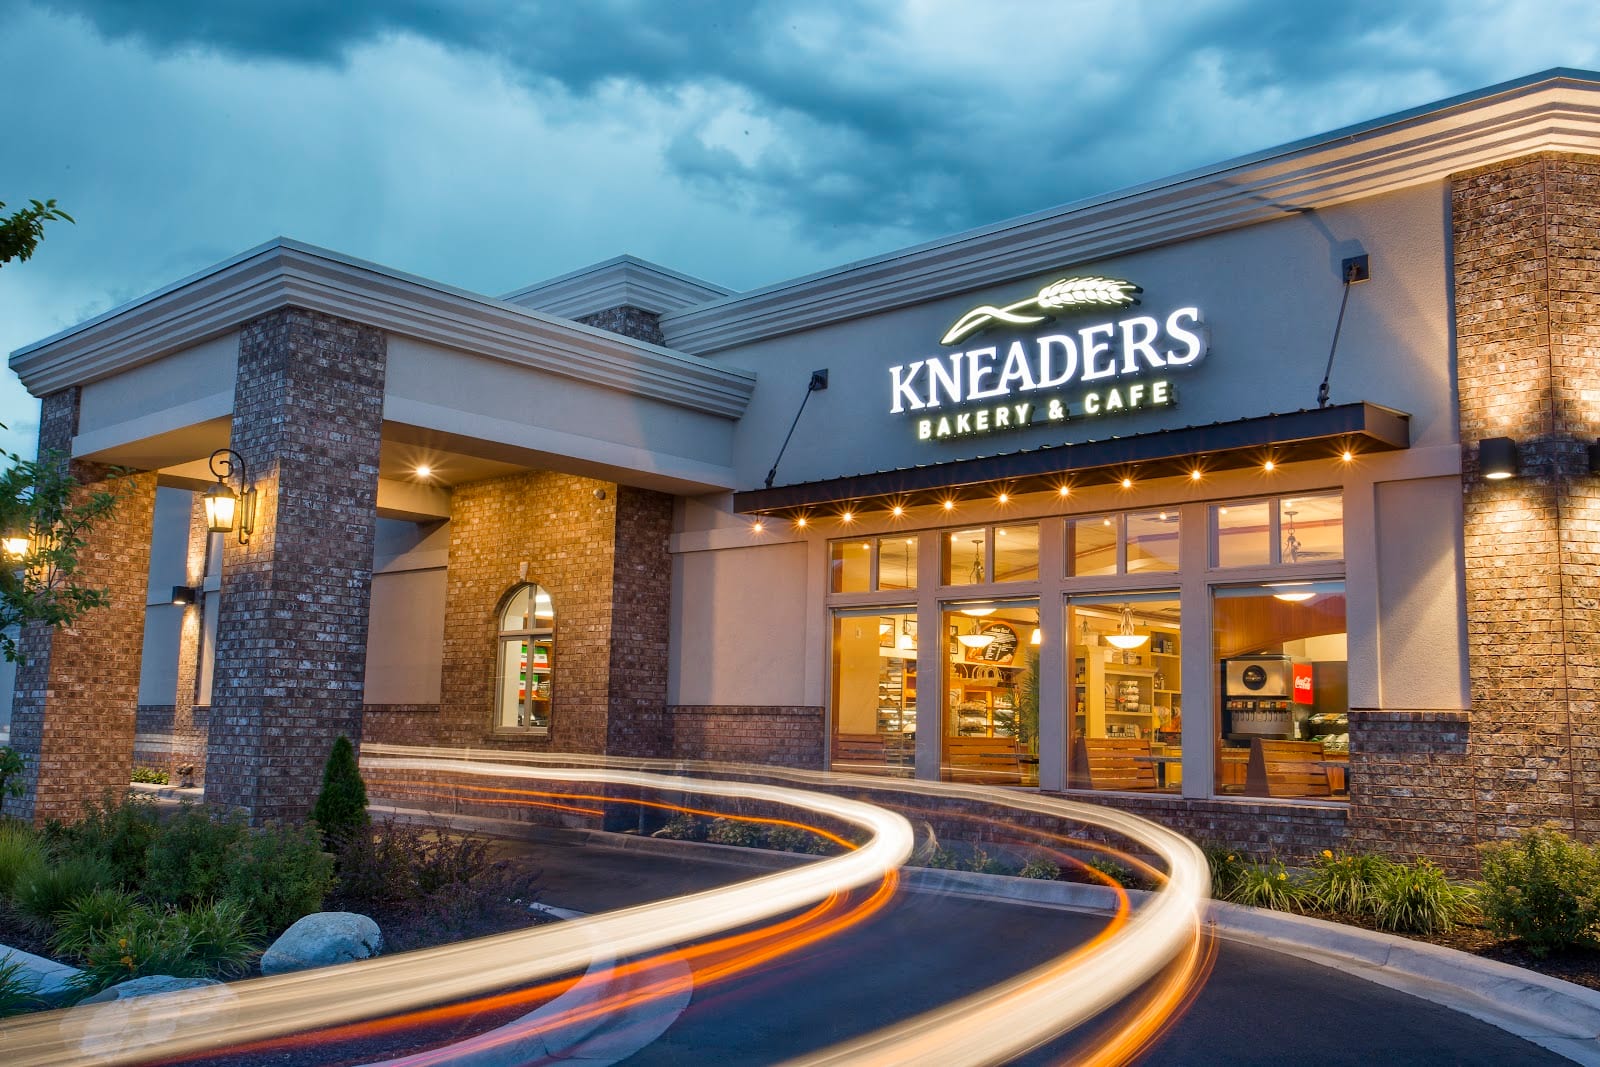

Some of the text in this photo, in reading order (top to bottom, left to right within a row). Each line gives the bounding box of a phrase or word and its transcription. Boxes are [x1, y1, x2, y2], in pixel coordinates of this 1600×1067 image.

[889, 307, 1201, 414] KNEADERS
[918, 381, 1169, 440] BAKERY & CAFE
